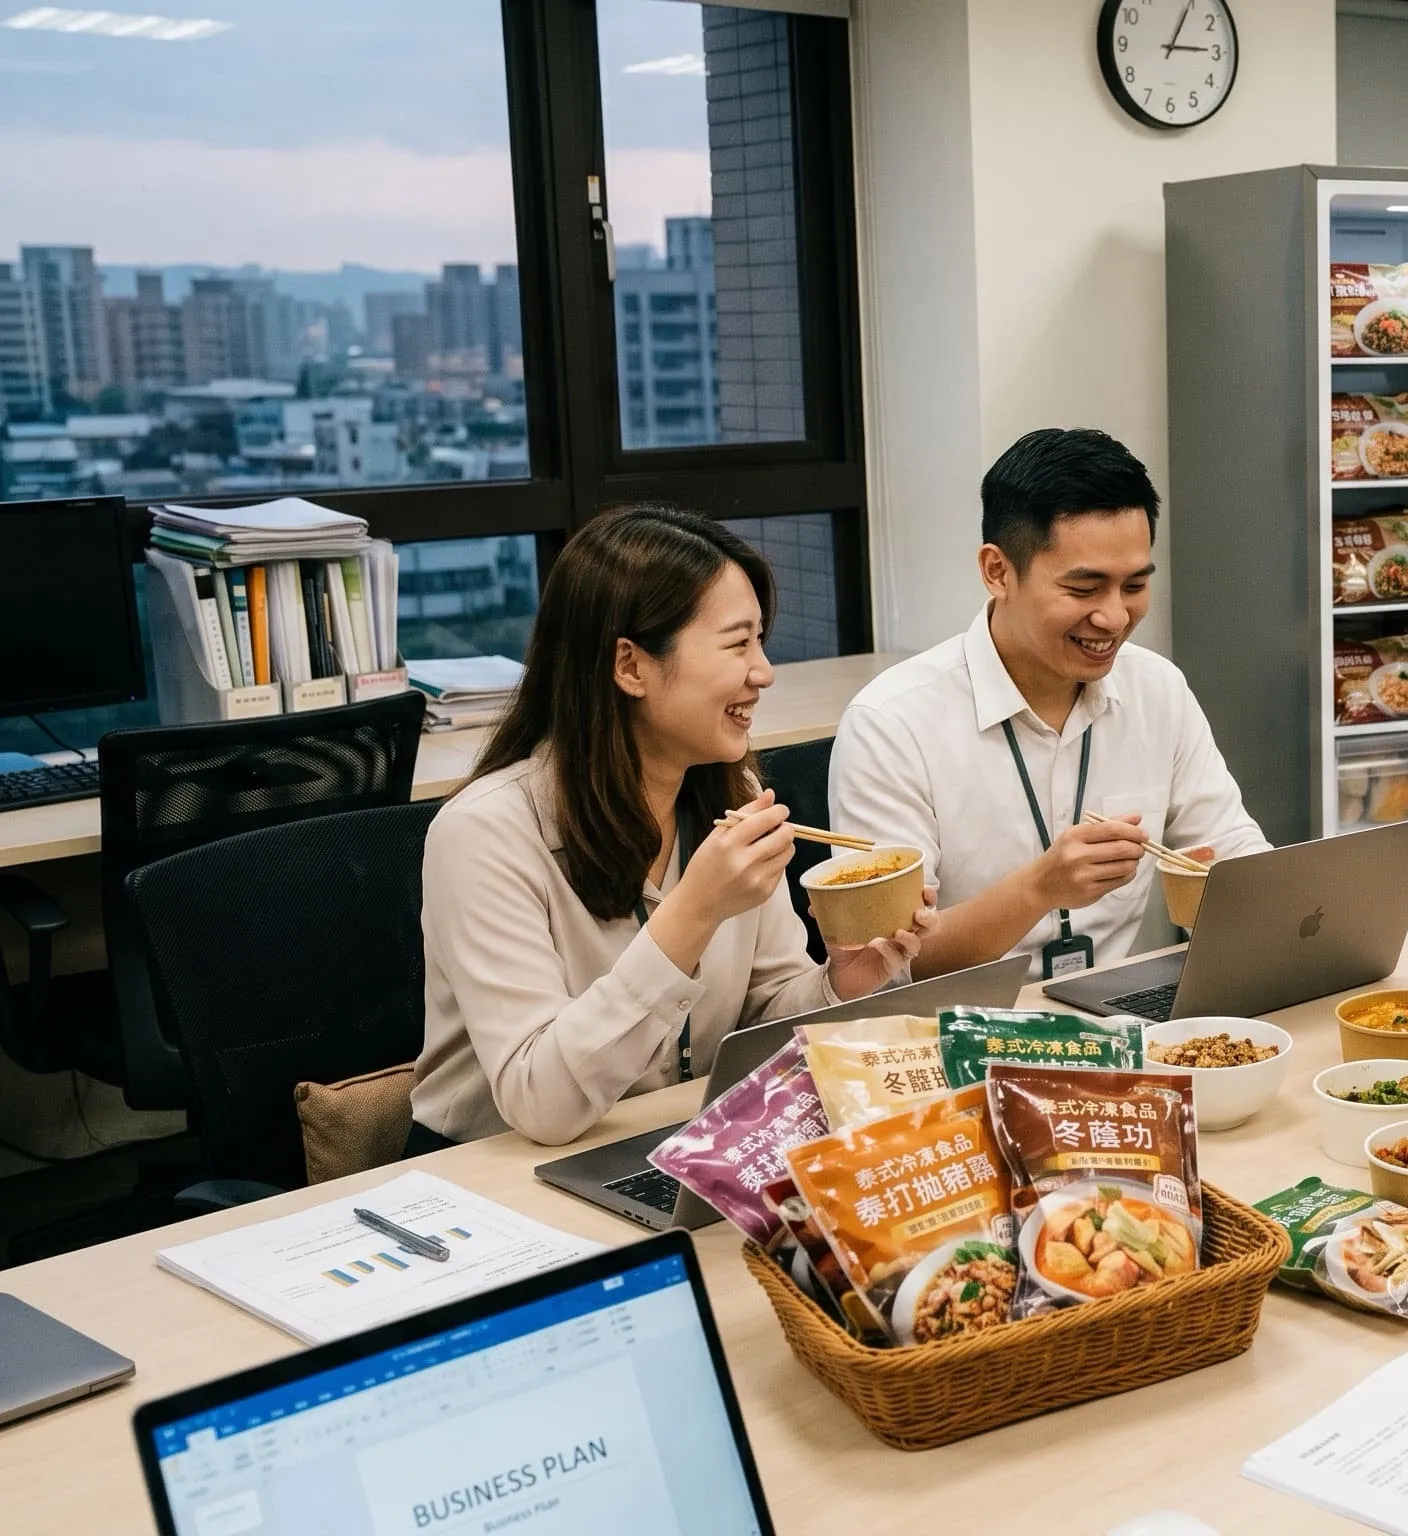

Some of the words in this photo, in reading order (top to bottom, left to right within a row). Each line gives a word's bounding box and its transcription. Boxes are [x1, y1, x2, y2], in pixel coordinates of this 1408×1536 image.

[1122, 8, 1138, 25] 10
[1205, 14, 1215, 31] 2
[1118, 36, 1128, 52] 9
[1211, 44, 1221, 61] 3
[1125, 66, 1135, 83] 8
[1205, 73, 1214, 88] 4
[1144, 88, 1152, 105] 7
[1166, 97, 1175, 113] 6
[1189, 91, 1198, 108] 5
[1055, 1119, 1152, 1149] 冬蔭功
[854, 1133, 974, 1191] 泰式冷凍食品
[412, 1463, 537, 1528] BUSINESS
[542, 1436, 608, 1479] PLAN
